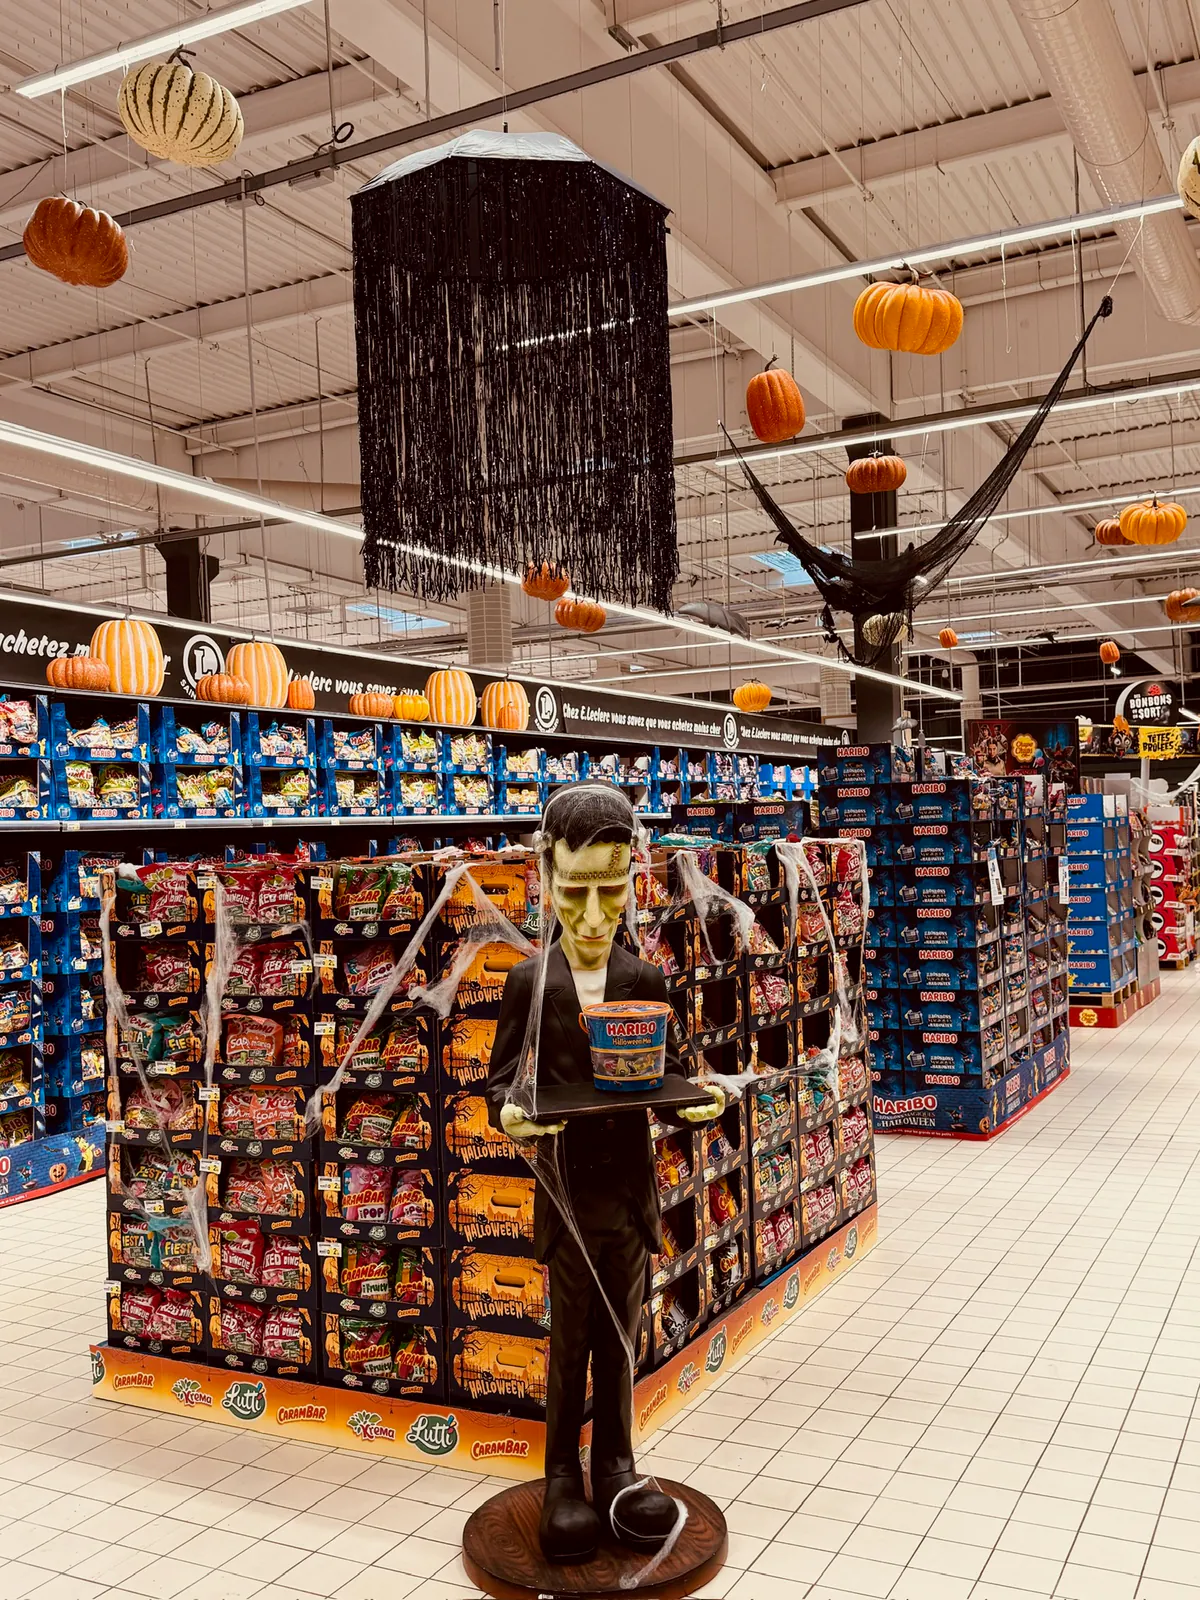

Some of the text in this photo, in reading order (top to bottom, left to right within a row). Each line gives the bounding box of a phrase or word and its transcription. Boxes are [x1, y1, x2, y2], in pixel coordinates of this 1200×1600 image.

[335, 678, 361, 693] vous
[1129, 694, 1172, 709] BONBONS
[562, 703, 579, 720] Chez
[580, 706, 611, 724] E.Leclerc
[611, 711, 627, 725] vous
[627, 713, 645, 727] savez
[645, 717, 657, 732] que
[658, 718, 672, 730] vous
[671, 718, 694, 734] achetez
[694, 721, 710, 734] moins
[90, 748, 117, 759] HARIBO
[837, 746, 869, 757] HARIBO
[838, 787, 870, 798] HARIBO
[912, 781, 946, 794] HARIBO
[1067, 796, 1087, 805] ARIBO
[92, 808, 117, 819] HARIBO
[687, 807, 715, 817] HARIBO
[754, 805, 785, 816] HARIBO
[913, 825, 948, 836] HARIBO
[1067, 829, 1089, 838] ARIBO
[915, 866, 950, 877] HARIBO
[1067, 862, 1090, 871] ARIBO
[1069, 895, 1092, 904] ARIBO
[916, 908, 952, 919] HARIBO
[919, 950, 954, 961] HARIBO
[1069, 960, 1097, 969] HARIBO
[456, 988, 503, 1010] HALLOWEE
[920, 991, 956, 1002] HARIBO
[606, 1021, 656, 1036] HARIBO
[121, 1029, 144, 1044] IESTA
[922, 1033, 958, 1044] HARIBO
[925, 1074, 960, 1086] HARIBO
[873, 1094, 938, 1116] HARIBO
[460, 1143, 516, 1164] HALLOWEEN
[342, 1189, 386, 1208] ARAMBAR
[359, 1207, 384, 1219] iPOP
[463, 1220, 520, 1242] HALLOWEEN
[121, 1233, 146, 1248] IESTA
[164, 1240, 194, 1256] FIEST
[467, 1301, 523, 1321] HALLOWEEN
[221, 1312, 238, 1330] ED
[113, 1373, 154, 1391] CARAMBAR
[468, 1379, 525, 1399] HALLOWEEN
[184, 1389, 213, 1407] Krema
[221, 1383, 264, 1416] Lutti
[277, 1404, 327, 1424] CARAMBAR
[360, 1423, 396, 1441] Krema
[406, 1414, 455, 1450] Lutti
[470, 1440, 530, 1460] CARAMBAR
